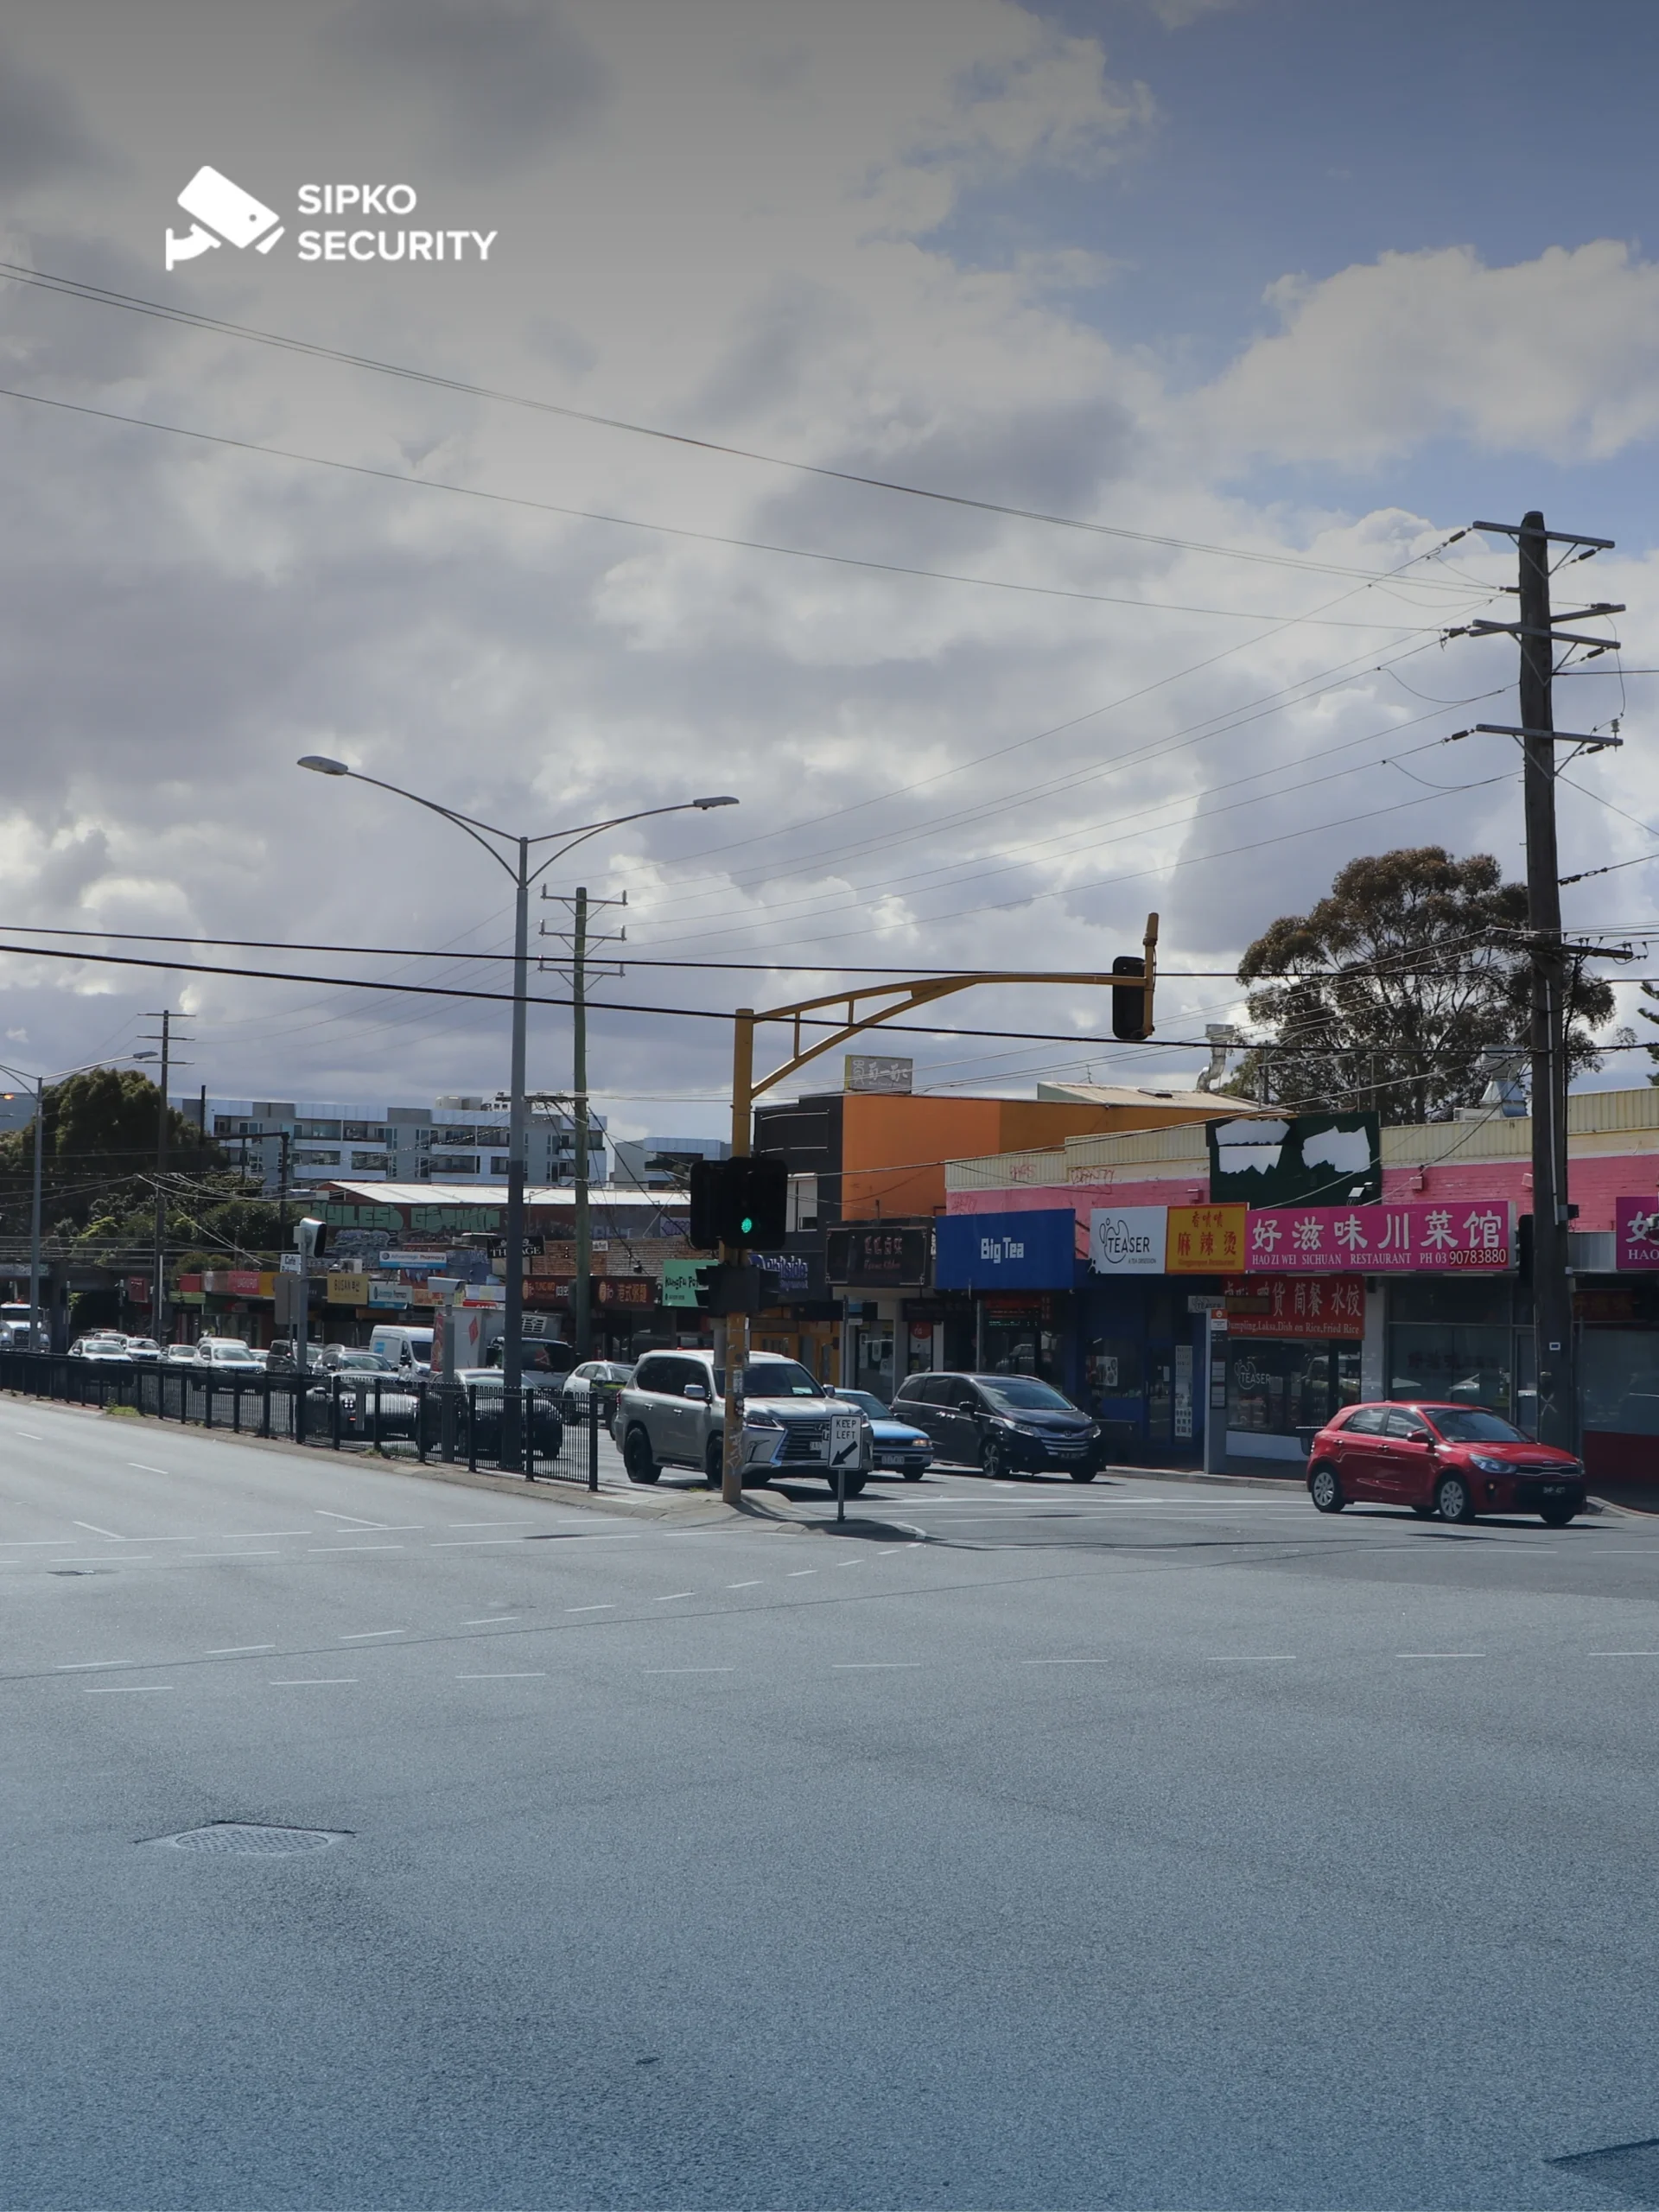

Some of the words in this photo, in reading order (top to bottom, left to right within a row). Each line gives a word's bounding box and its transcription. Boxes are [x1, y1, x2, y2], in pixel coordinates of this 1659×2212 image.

[1251, 1210, 1502, 1252] 好滋味川菜馆
[981, 1238, 1001, 1263] Big
[1002, 1237, 1024, 1259] Tea
[1107, 1236, 1150, 1253] TEASER
[1178, 1230, 1236, 1256] 麻辣烫
[490, 1249, 507, 1257] TH
[1252, 1254, 1269, 1265] HAO
[1271, 1255, 1279, 1265] ZI
[1281, 1255, 1297, 1265] WEI
[1302, 1253, 1341, 1265] SICHUAN
[1351, 1252, 1412, 1265] RESTAURANT
[1420, 1252, 1433, 1264] PH
[1435, 1252, 1447, 1263] 03
[1449, 1249, 1507, 1264] 90783880
[1294, 1282, 1323, 1317] 简餐
[1331, 1283, 1362, 1317] 水饺
[1344, 1323, 1359, 1334] Rice
[1240, 1372, 1271, 1384] TEASER
[836, 1419, 856, 1427] KEEP
[836, 1430, 856, 1440] LEFT
